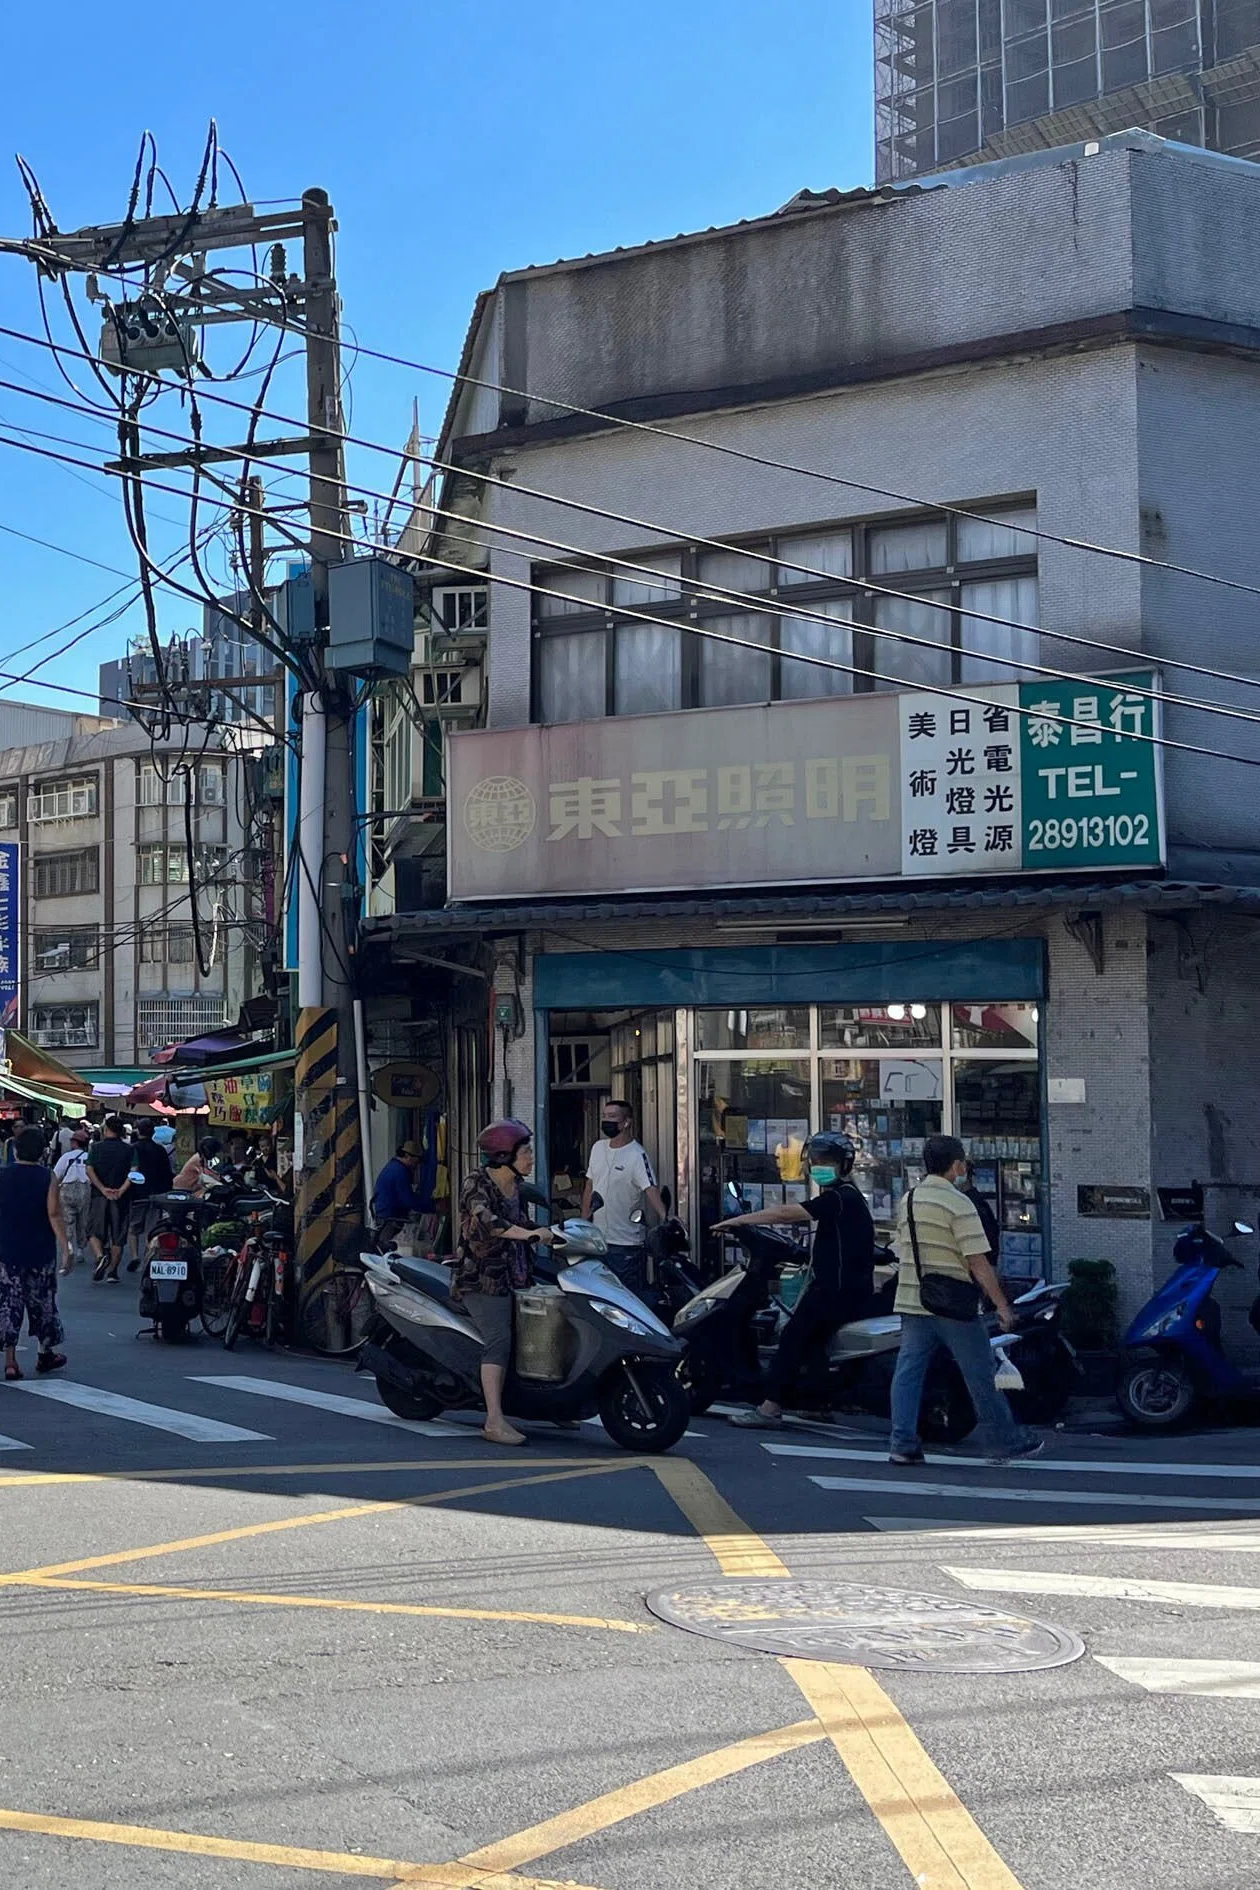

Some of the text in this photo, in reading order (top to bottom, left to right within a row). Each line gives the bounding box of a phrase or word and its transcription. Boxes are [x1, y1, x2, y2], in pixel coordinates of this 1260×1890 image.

[1027, 694, 1146, 748] 泰昌行
[545, 754, 891, 841] 東亞照明
[908, 711, 938, 856] 美術燈
[945, 709, 976, 854] 日光燈具
[982, 705, 1014, 852] 省電光源
[469, 800, 531, 828] 東亞
[1029, 814, 1149, 850] 28913102
[151, 1265, 186, 1276] NAL-8910
